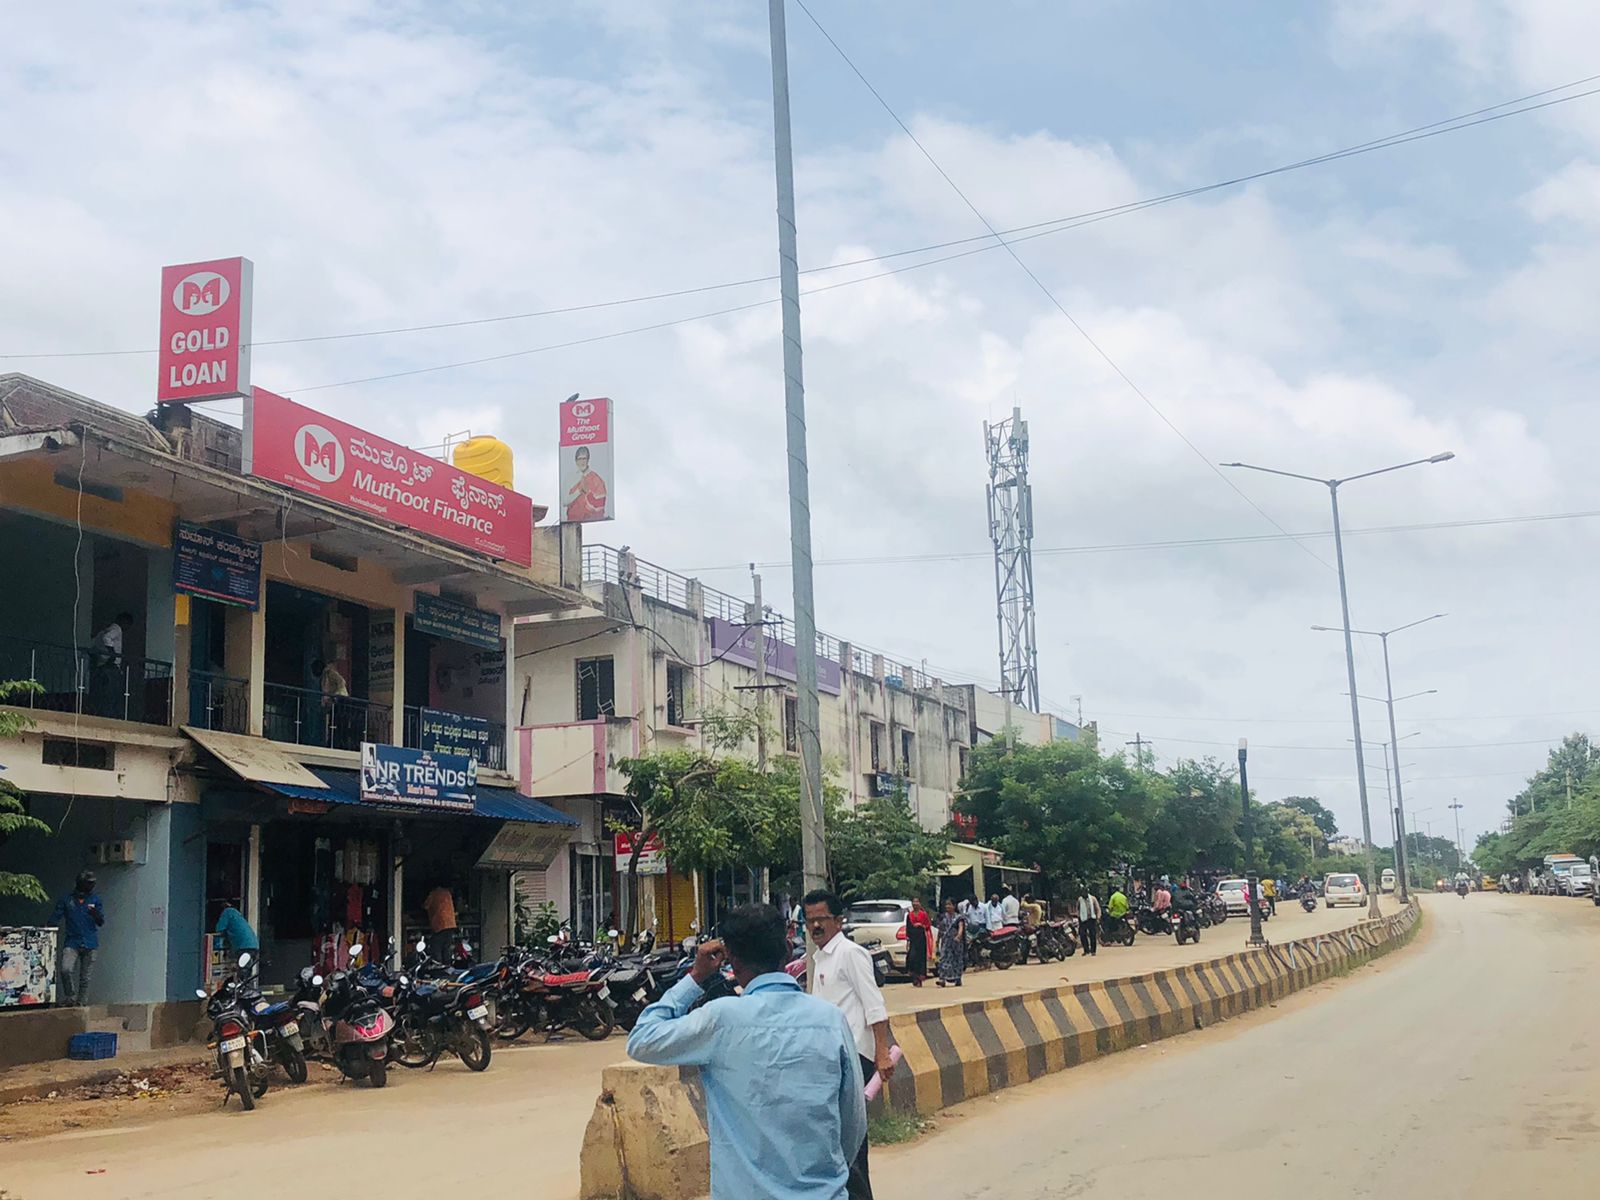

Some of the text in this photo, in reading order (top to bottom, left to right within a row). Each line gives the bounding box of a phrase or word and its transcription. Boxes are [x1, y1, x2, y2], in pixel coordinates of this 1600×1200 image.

[171, 326, 229, 354] GOLD
[170, 360, 227, 387] LOAN
[566, 424, 600, 433] Muthoot
[352, 469, 431, 512] Muthoot
[432, 499, 493, 535] Finance
[451, 475, 506, 517] ಫೈನಾನ್ಸ್
[376, 760, 466, 787] NR TRENDS
